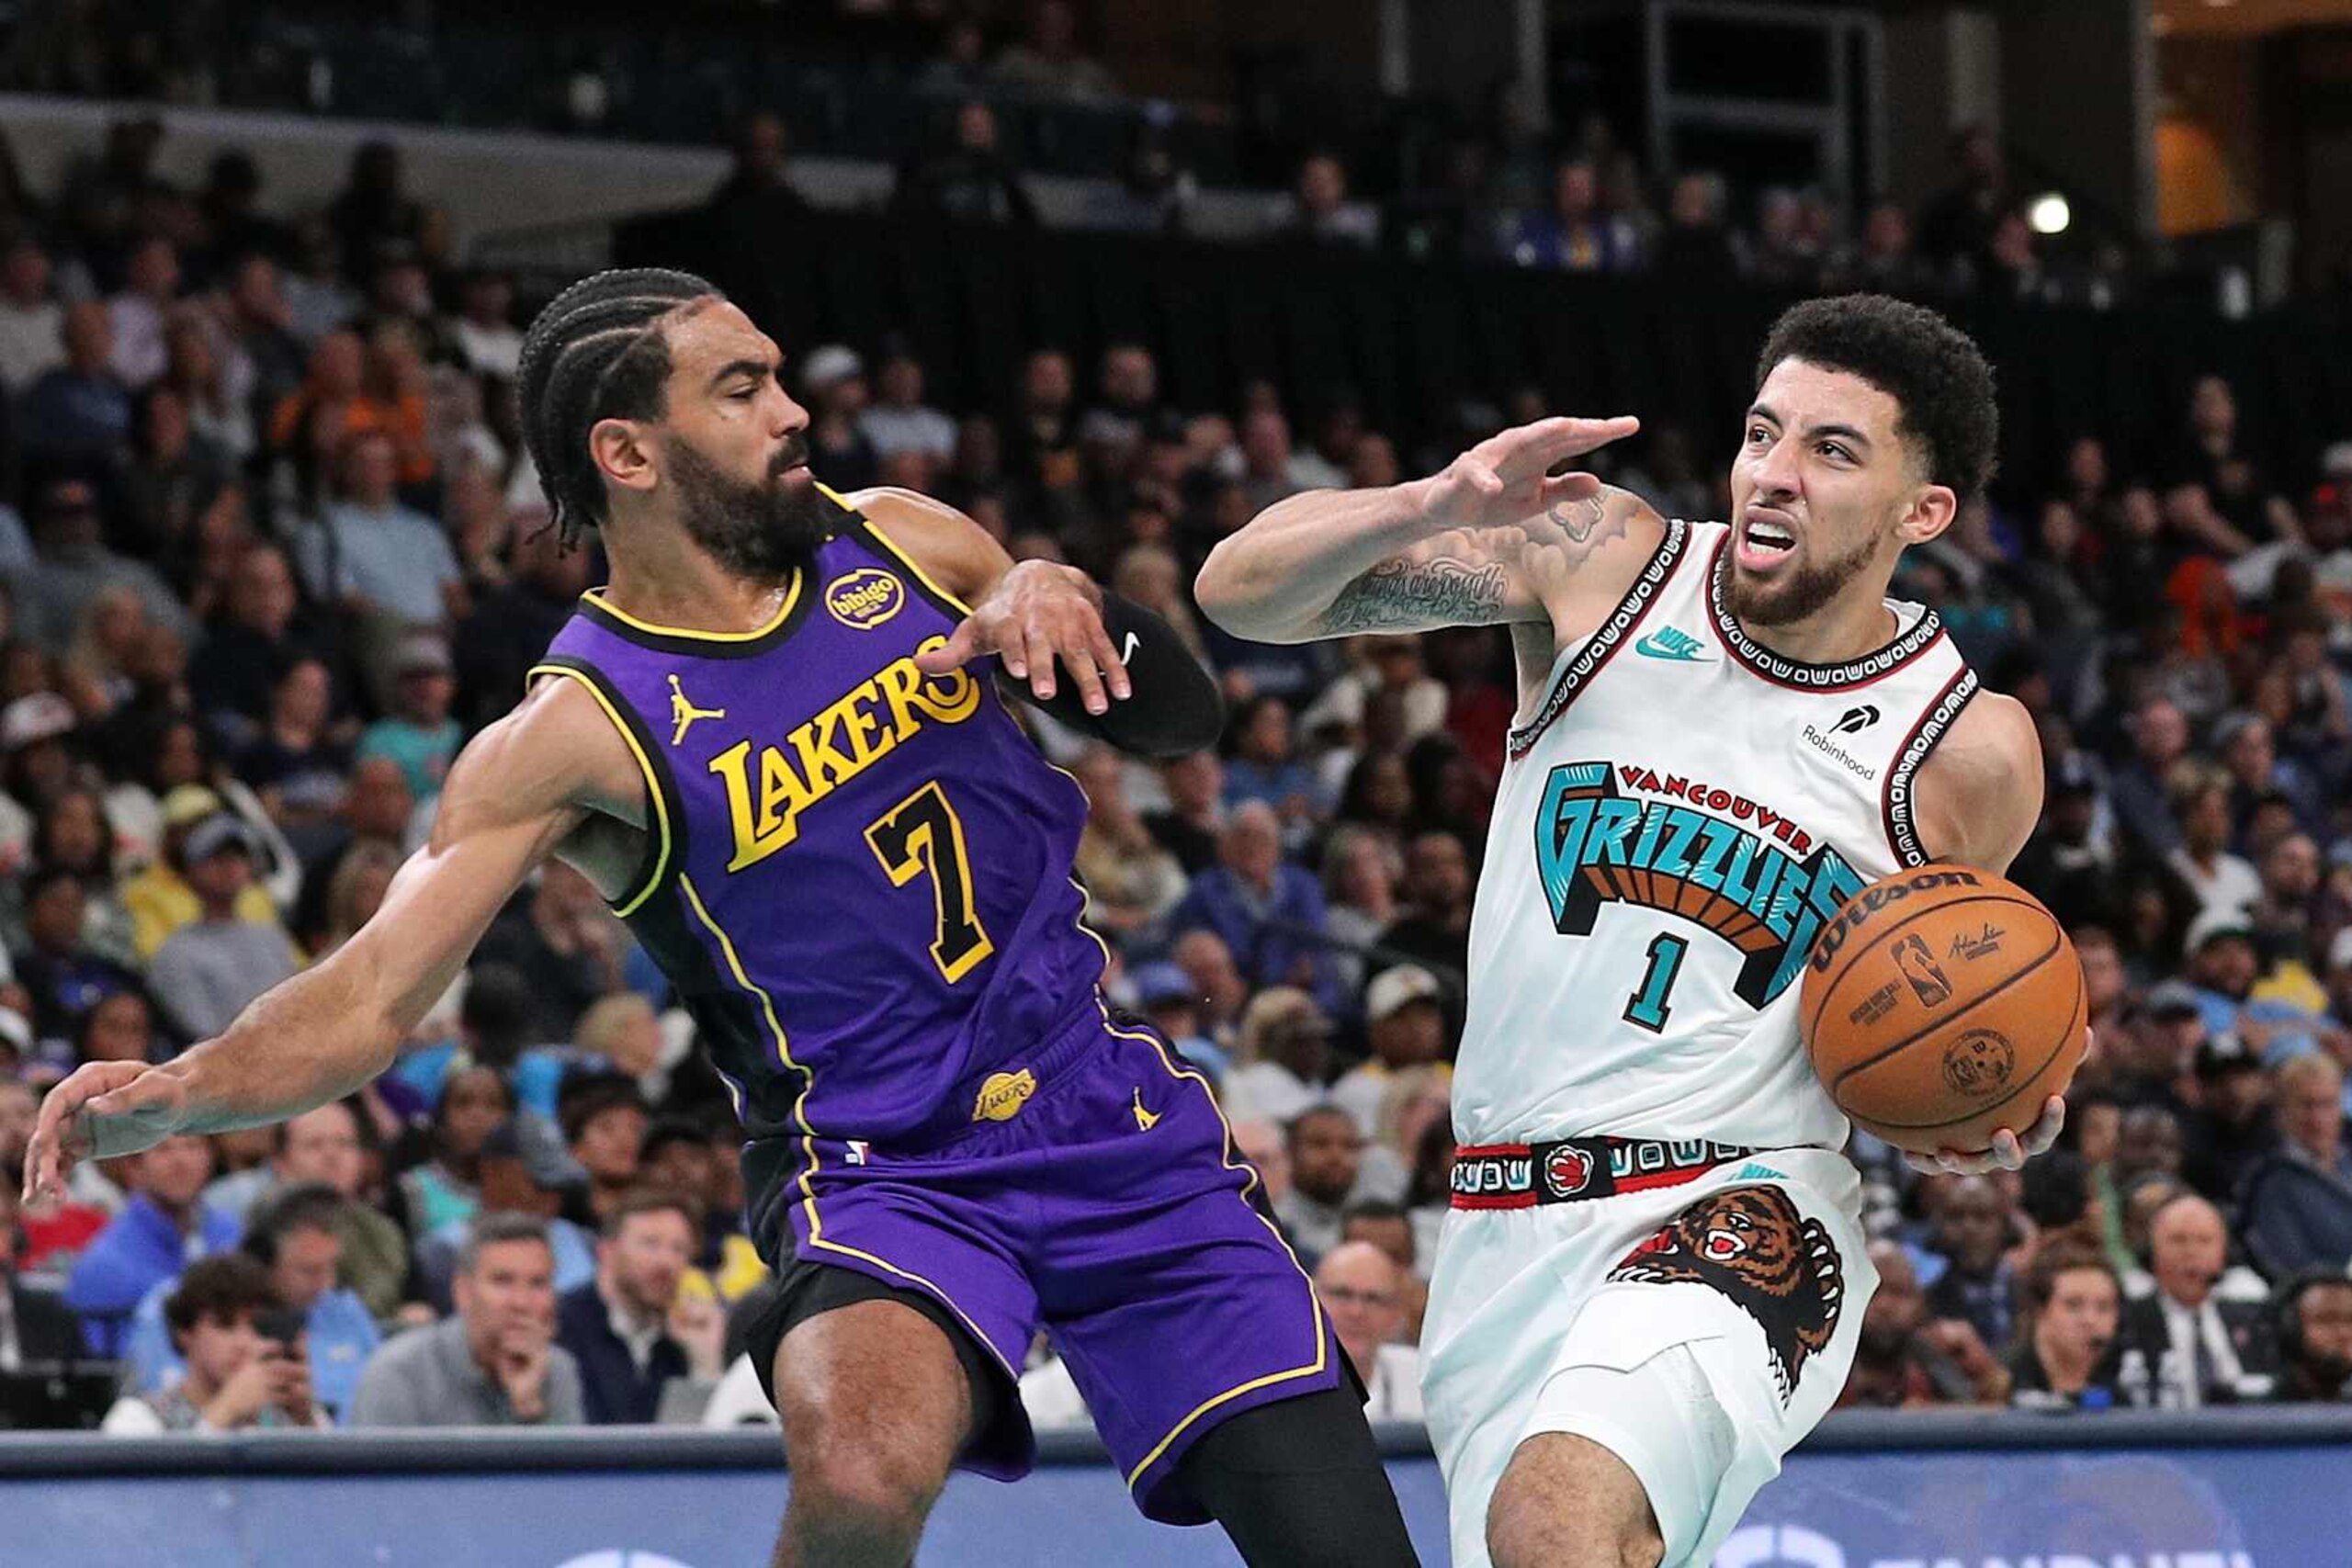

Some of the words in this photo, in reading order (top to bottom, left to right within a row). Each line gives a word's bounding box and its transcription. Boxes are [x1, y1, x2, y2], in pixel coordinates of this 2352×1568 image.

[831, 578, 895, 616] bibigo
[1651, 625, 1704, 651] NIKE
[709, 634, 980, 873] LAKERS
[1802, 724, 1876, 781] Robinhood
[1619, 765, 1812, 855] VANCOUVER
[862, 780, 995, 985] 7
[1622, 931, 1689, 1034] 1
